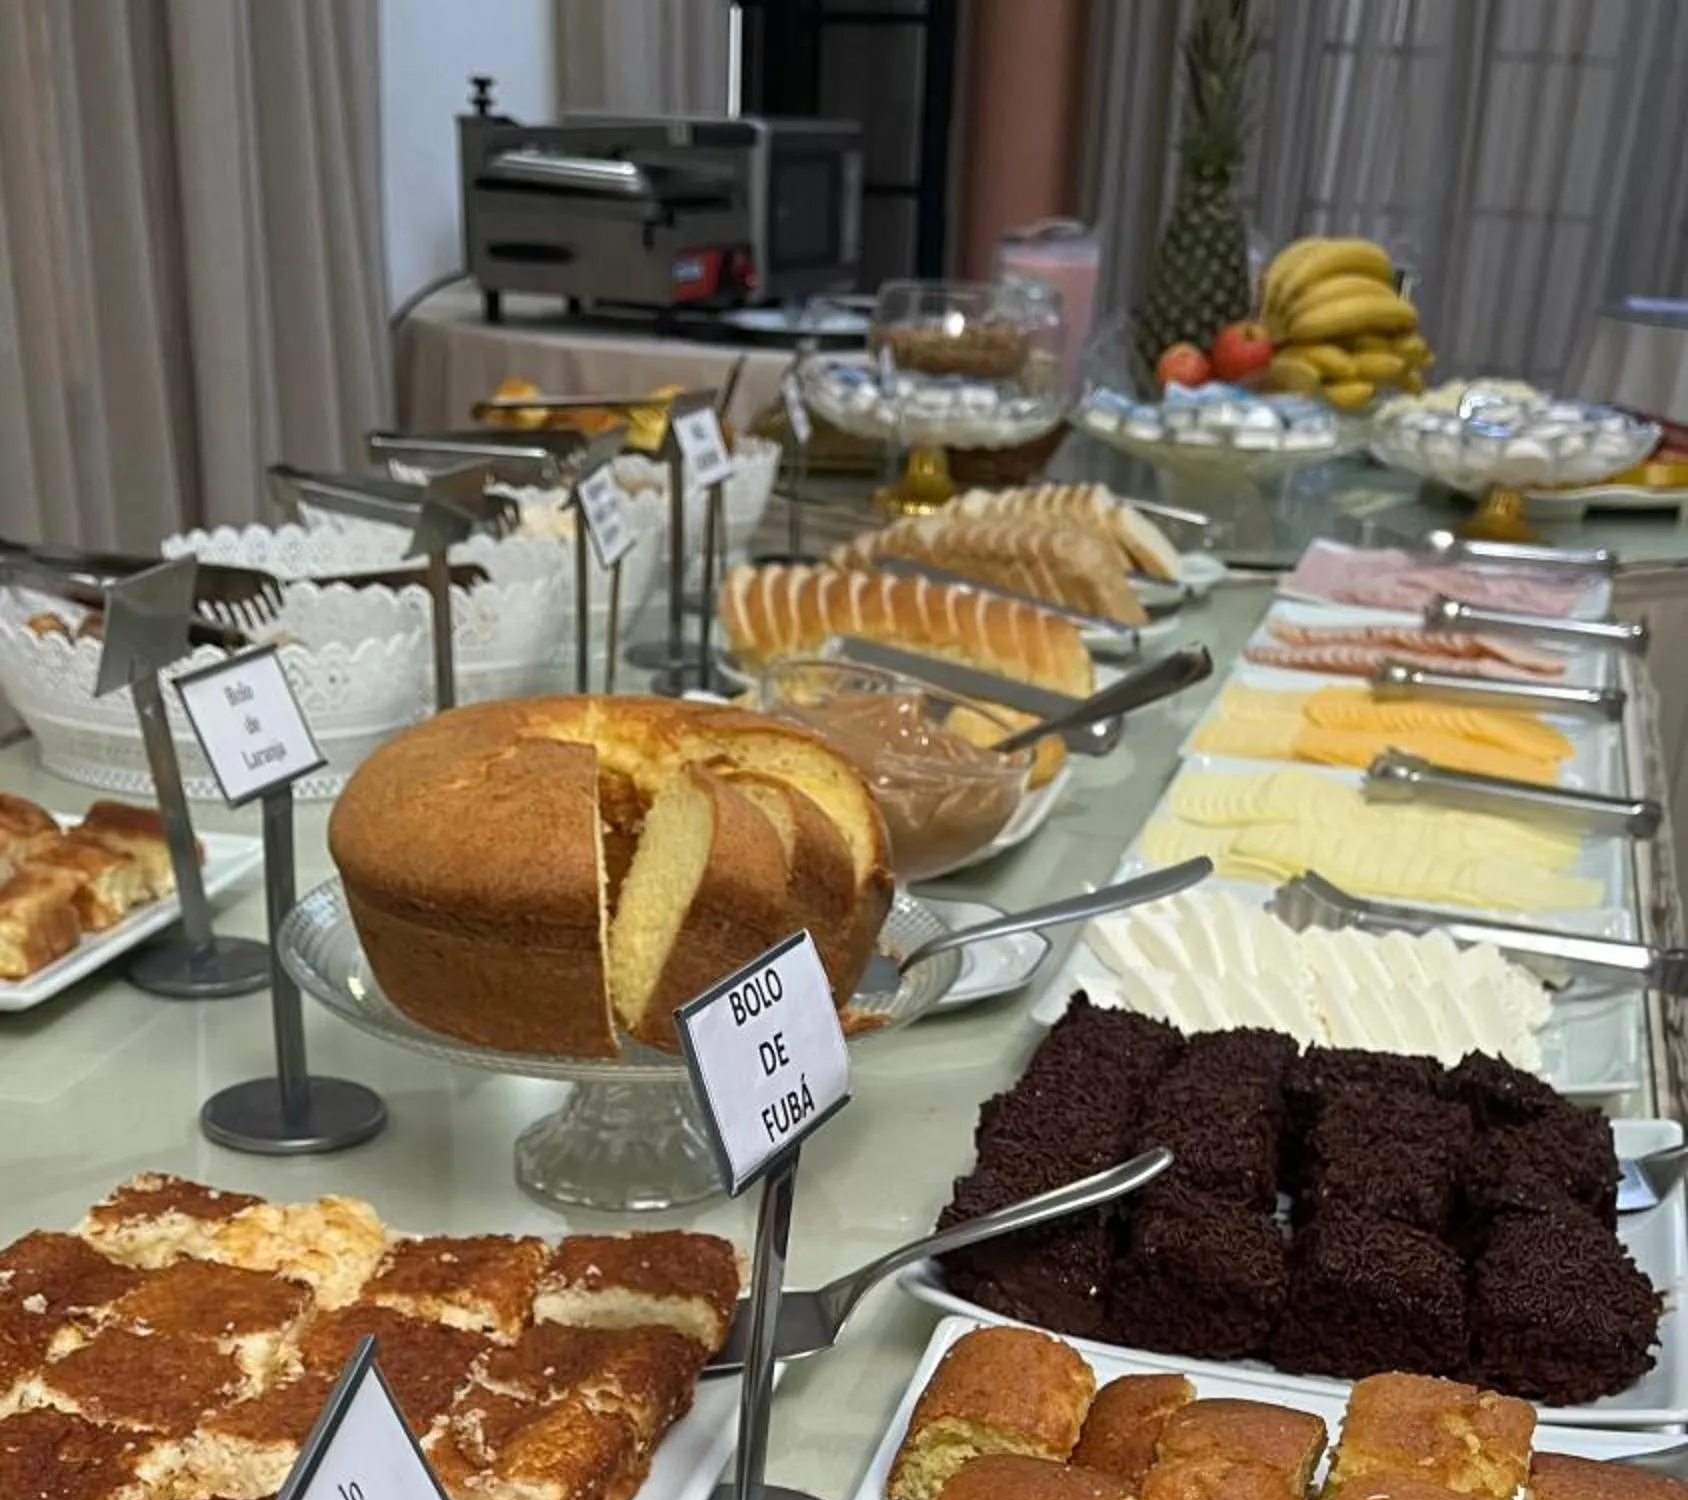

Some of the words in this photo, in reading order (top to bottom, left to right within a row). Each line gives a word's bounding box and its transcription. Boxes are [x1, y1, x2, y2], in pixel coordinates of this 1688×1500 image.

[729, 968, 783, 1026] BOLO
[759, 1032, 790, 1076] DE
[761, 1073, 815, 1142] FUBÁ
